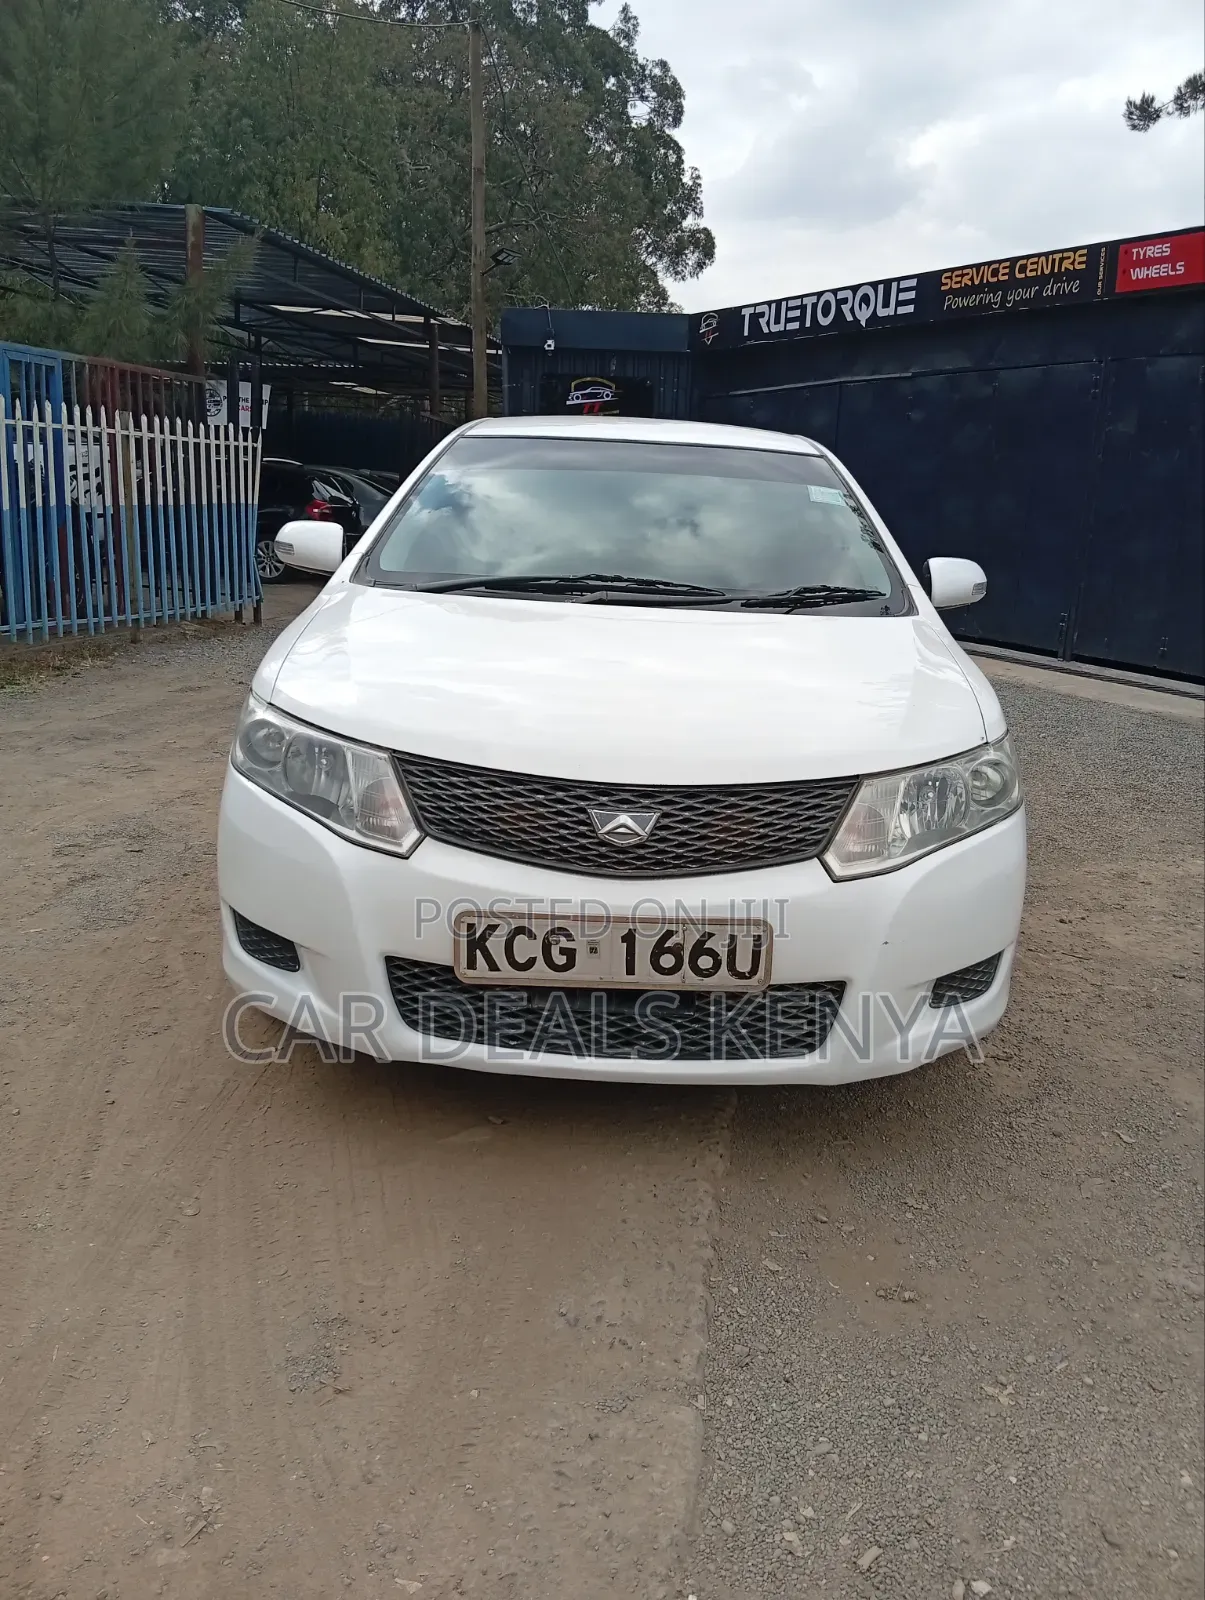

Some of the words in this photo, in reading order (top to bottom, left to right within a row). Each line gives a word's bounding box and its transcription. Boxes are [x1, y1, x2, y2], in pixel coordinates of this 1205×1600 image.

[940, 261, 1011, 291] SERVICE
[1014, 249, 1088, 279] CENTRE
[1130, 261, 1185, 280] WHEELS
[1131, 242, 1171, 261] TYRES
[741, 278, 918, 337] TRUETORQUE
[943, 287, 1002, 311] Powering
[1005, 286, 1039, 307] your
[1042, 276, 1080, 297] drive
[466, 922, 577, 973] KCG
[620, 928, 762, 980] 166U
